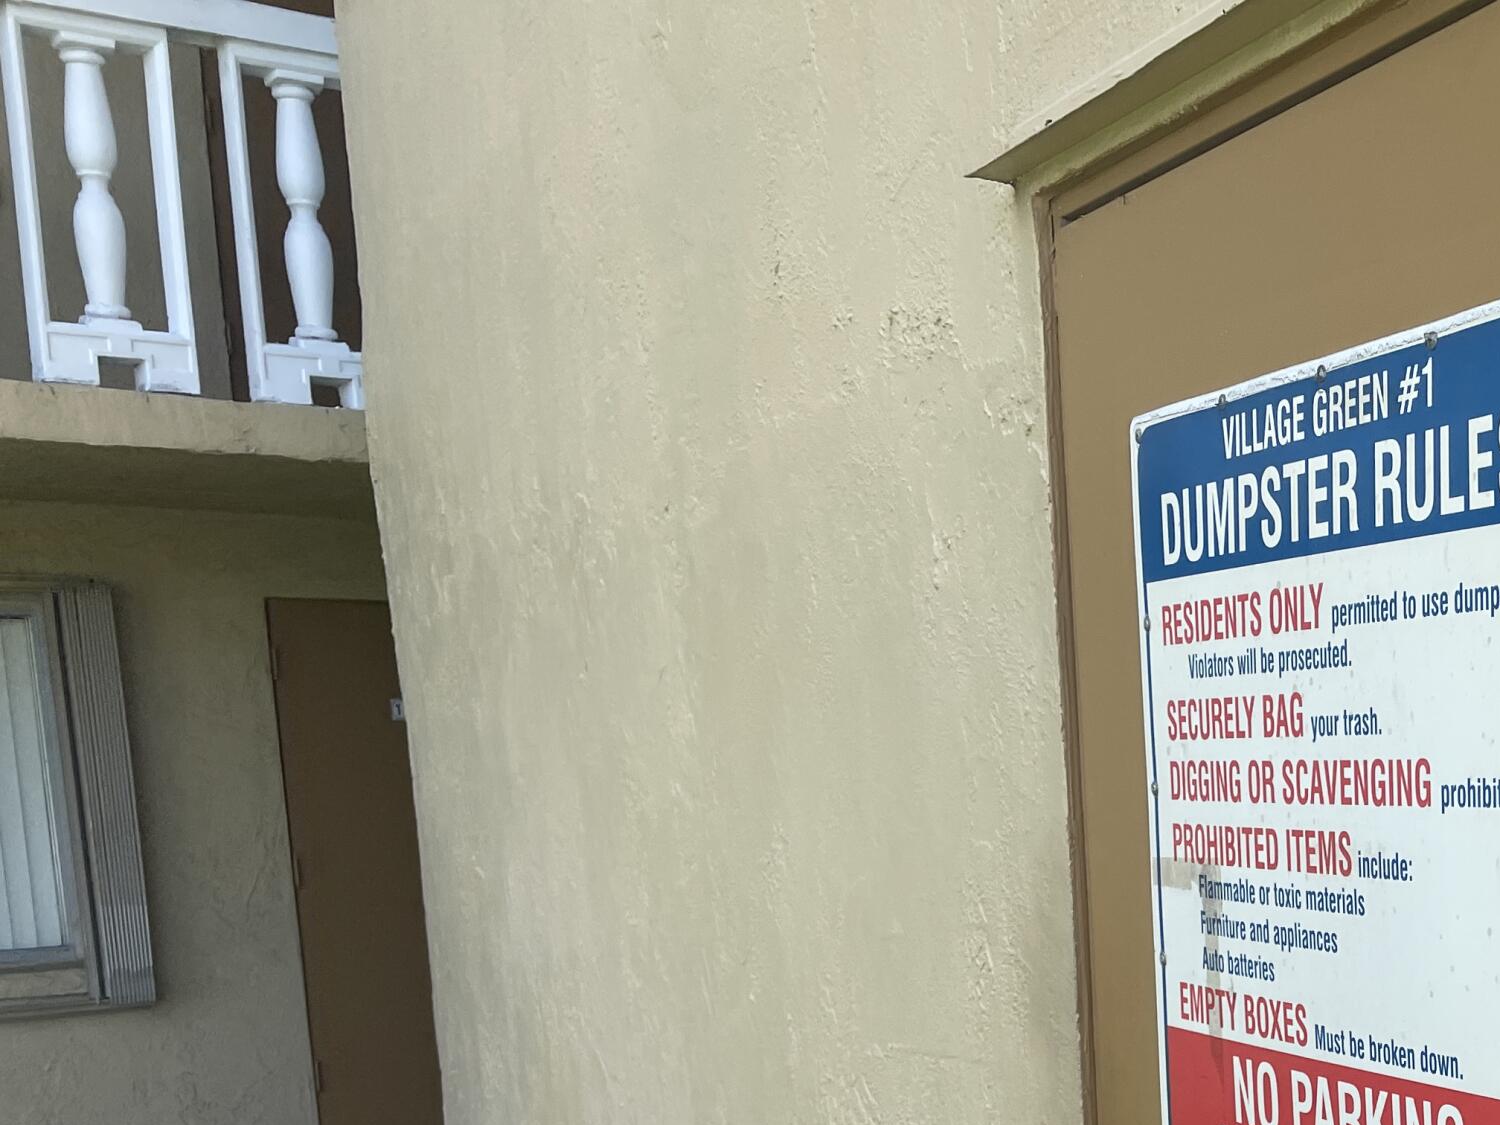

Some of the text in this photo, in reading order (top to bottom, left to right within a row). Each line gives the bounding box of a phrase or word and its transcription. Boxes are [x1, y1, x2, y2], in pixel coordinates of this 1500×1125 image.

[1222, 356, 1434, 459] VILLAGE GREEN #1
[1160, 448, 1359, 566] DUMPSTER
[1161, 591, 1262, 646] RESIDENTS
[1269, 582, 1324, 635] ONLY
[1331, 590, 1397, 634] permitted
[1402, 591, 1416, 619] to
[1422, 591, 1448, 617] use
[1188, 638, 1352, 679] Violators will be prosecuted.
[1167, 692, 1382, 743] SECURELY BAG your trash.
[1169, 760, 1242, 802] DIGGING
[1248, 760, 1276, 804] OR
[1282, 758, 1432, 808] SCAVENGING
[1172, 823, 1413, 881] PROHIBITED ITEMS include:
[1198, 874, 1365, 916] Flammable or toxic materials
[1200, 910, 1338, 953] Furniture and appliances
[1202, 947, 1275, 982] Auto batteries
[1179, 982, 1464, 1080] EMPTY BOXES Must be broken down.
